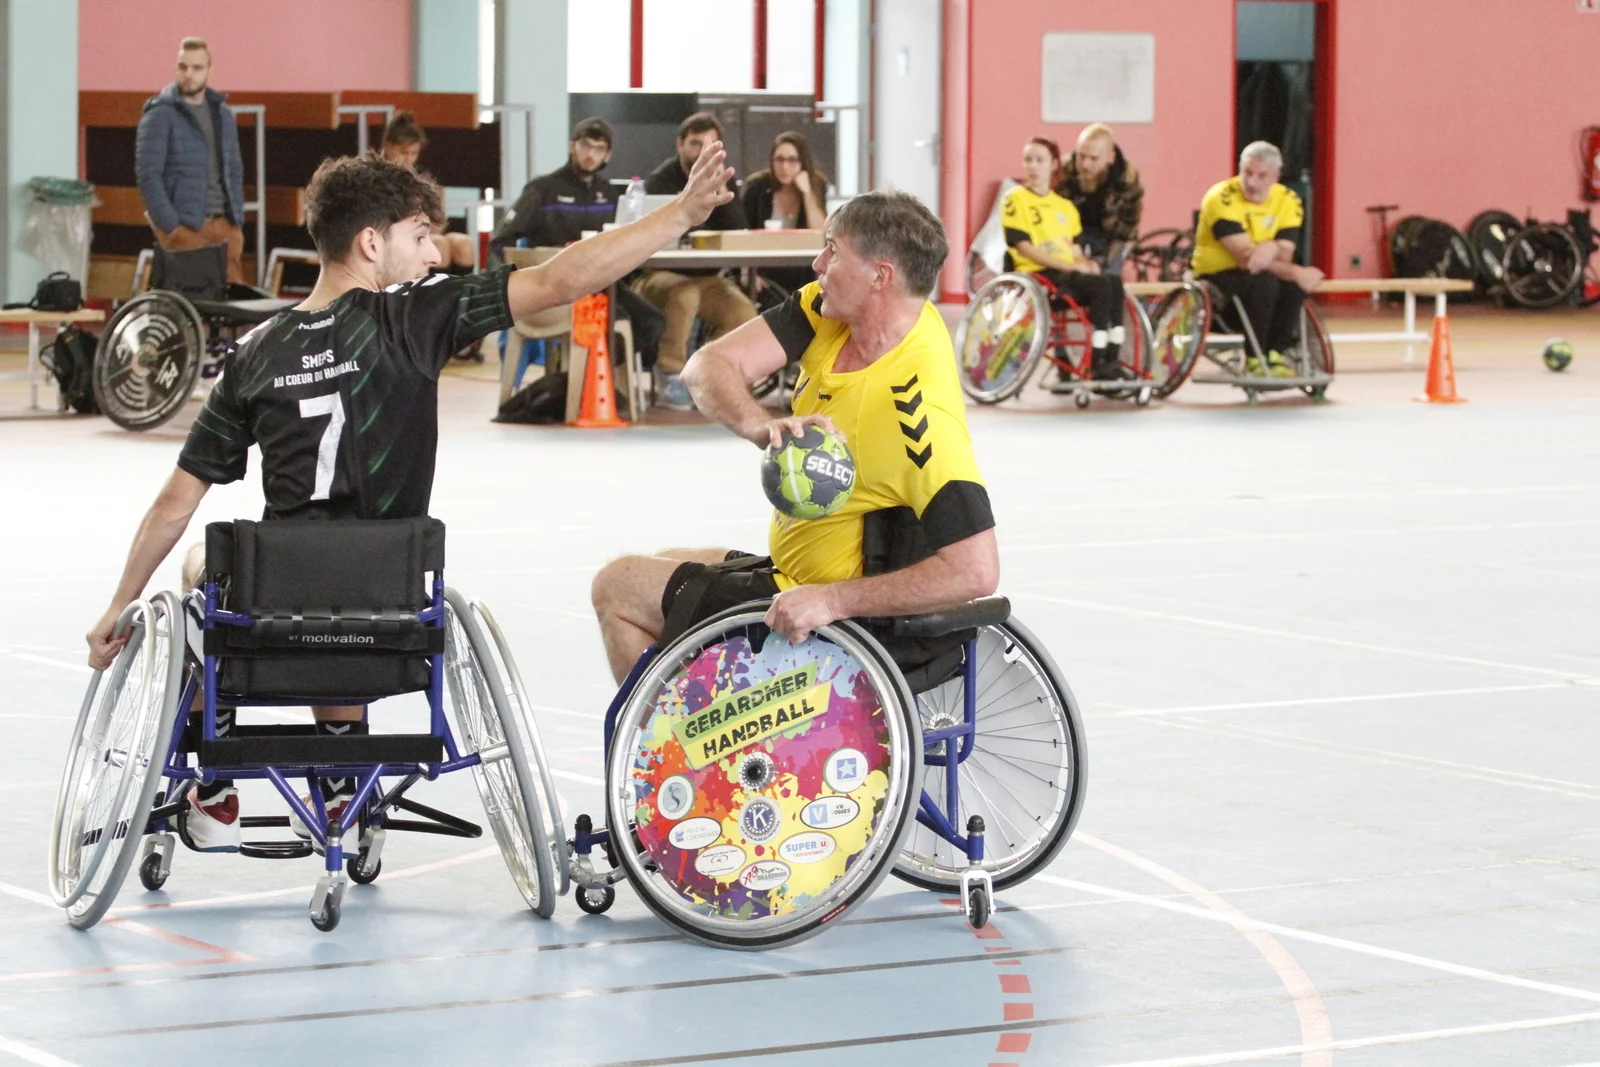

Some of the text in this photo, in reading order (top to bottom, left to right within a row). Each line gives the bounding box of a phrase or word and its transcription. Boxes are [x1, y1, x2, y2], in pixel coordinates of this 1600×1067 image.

[1029, 205, 1042, 226] 3
[273, 376, 284, 388] AU
[285, 372, 313, 386] COEUR
[298, 391, 346, 501] 7
[805, 455, 854, 487] SELECT
[301, 633, 375, 644] motivation
[684, 671, 809, 739] GERARDMER
[702, 698, 815, 759] HANDBALL
[752, 808, 767, 830] K
[785, 841, 817, 852] SUPER
